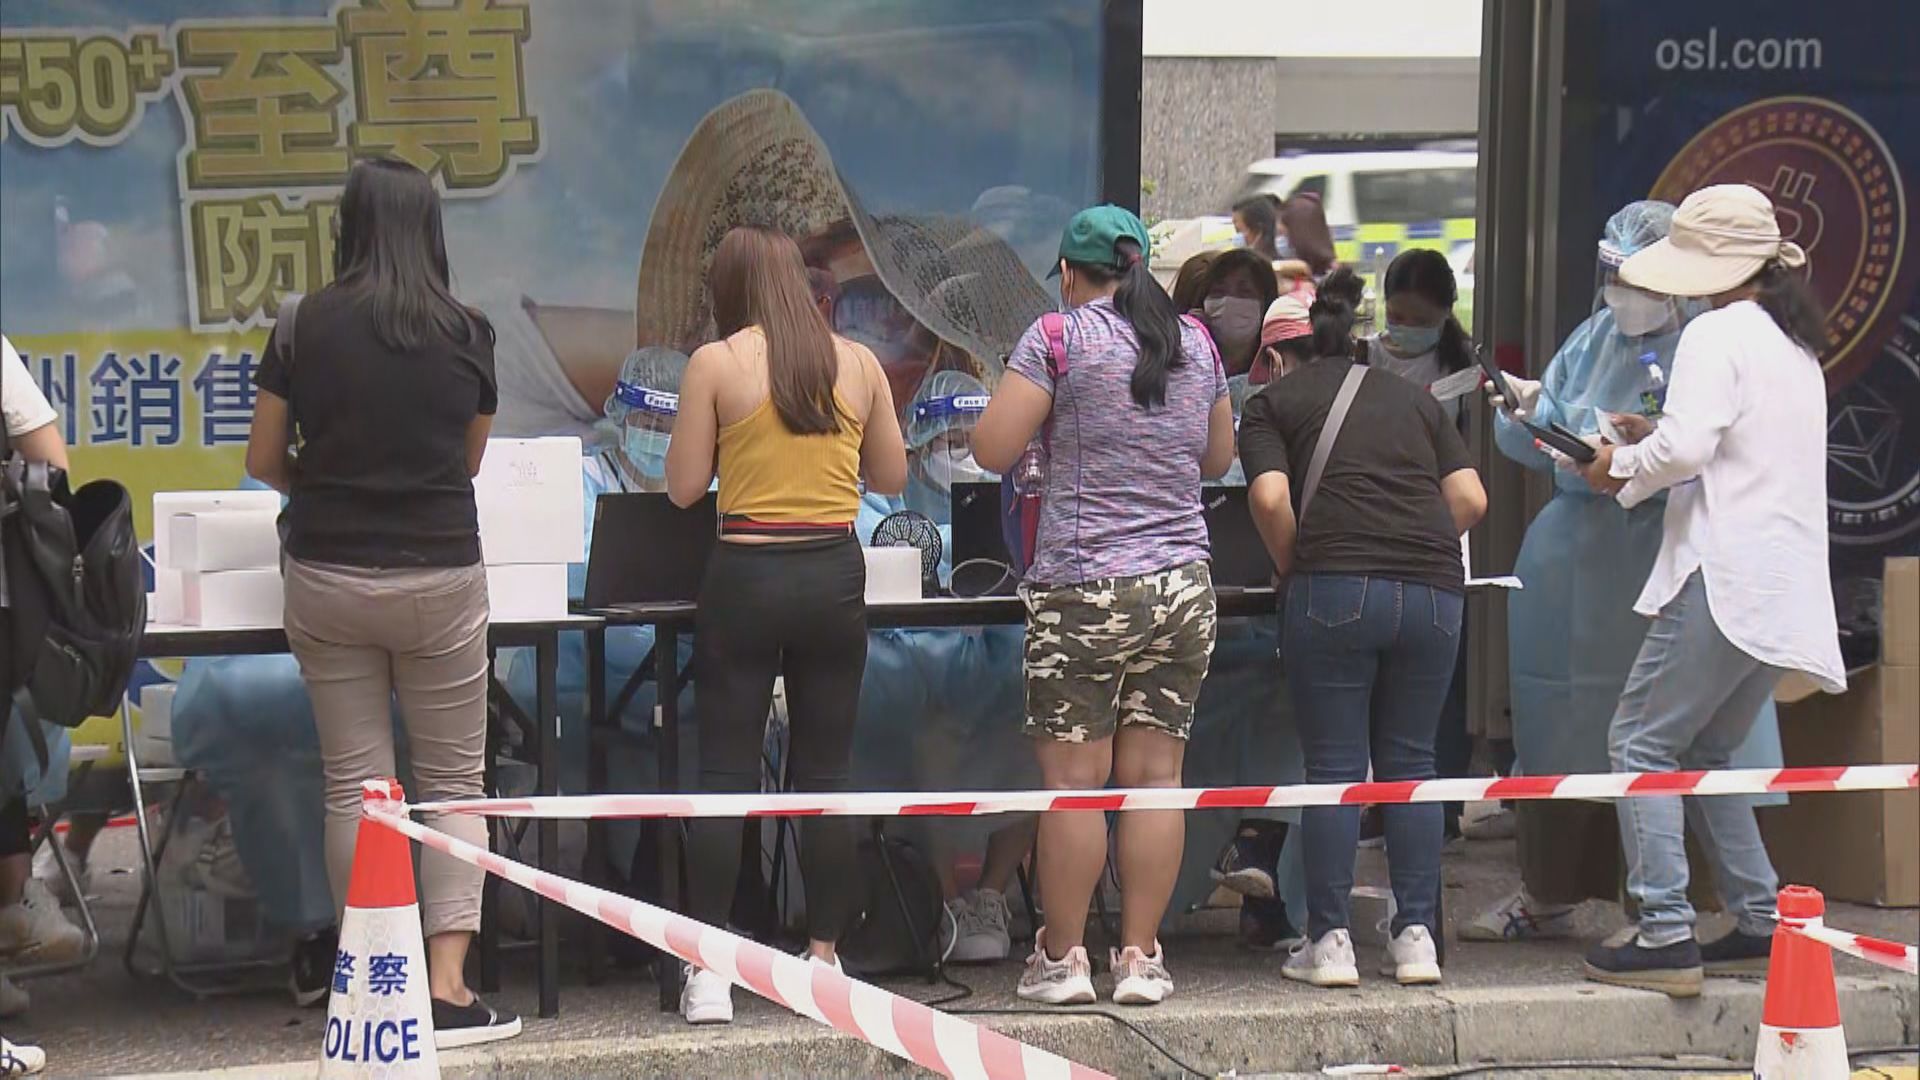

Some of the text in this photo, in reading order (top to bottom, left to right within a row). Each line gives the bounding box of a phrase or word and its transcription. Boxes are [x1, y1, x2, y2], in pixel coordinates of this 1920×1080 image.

[180, 0, 535, 180] 至尊
[1655, 26, 1823, 70] osl.com
[201, 200, 337, 310] 防
